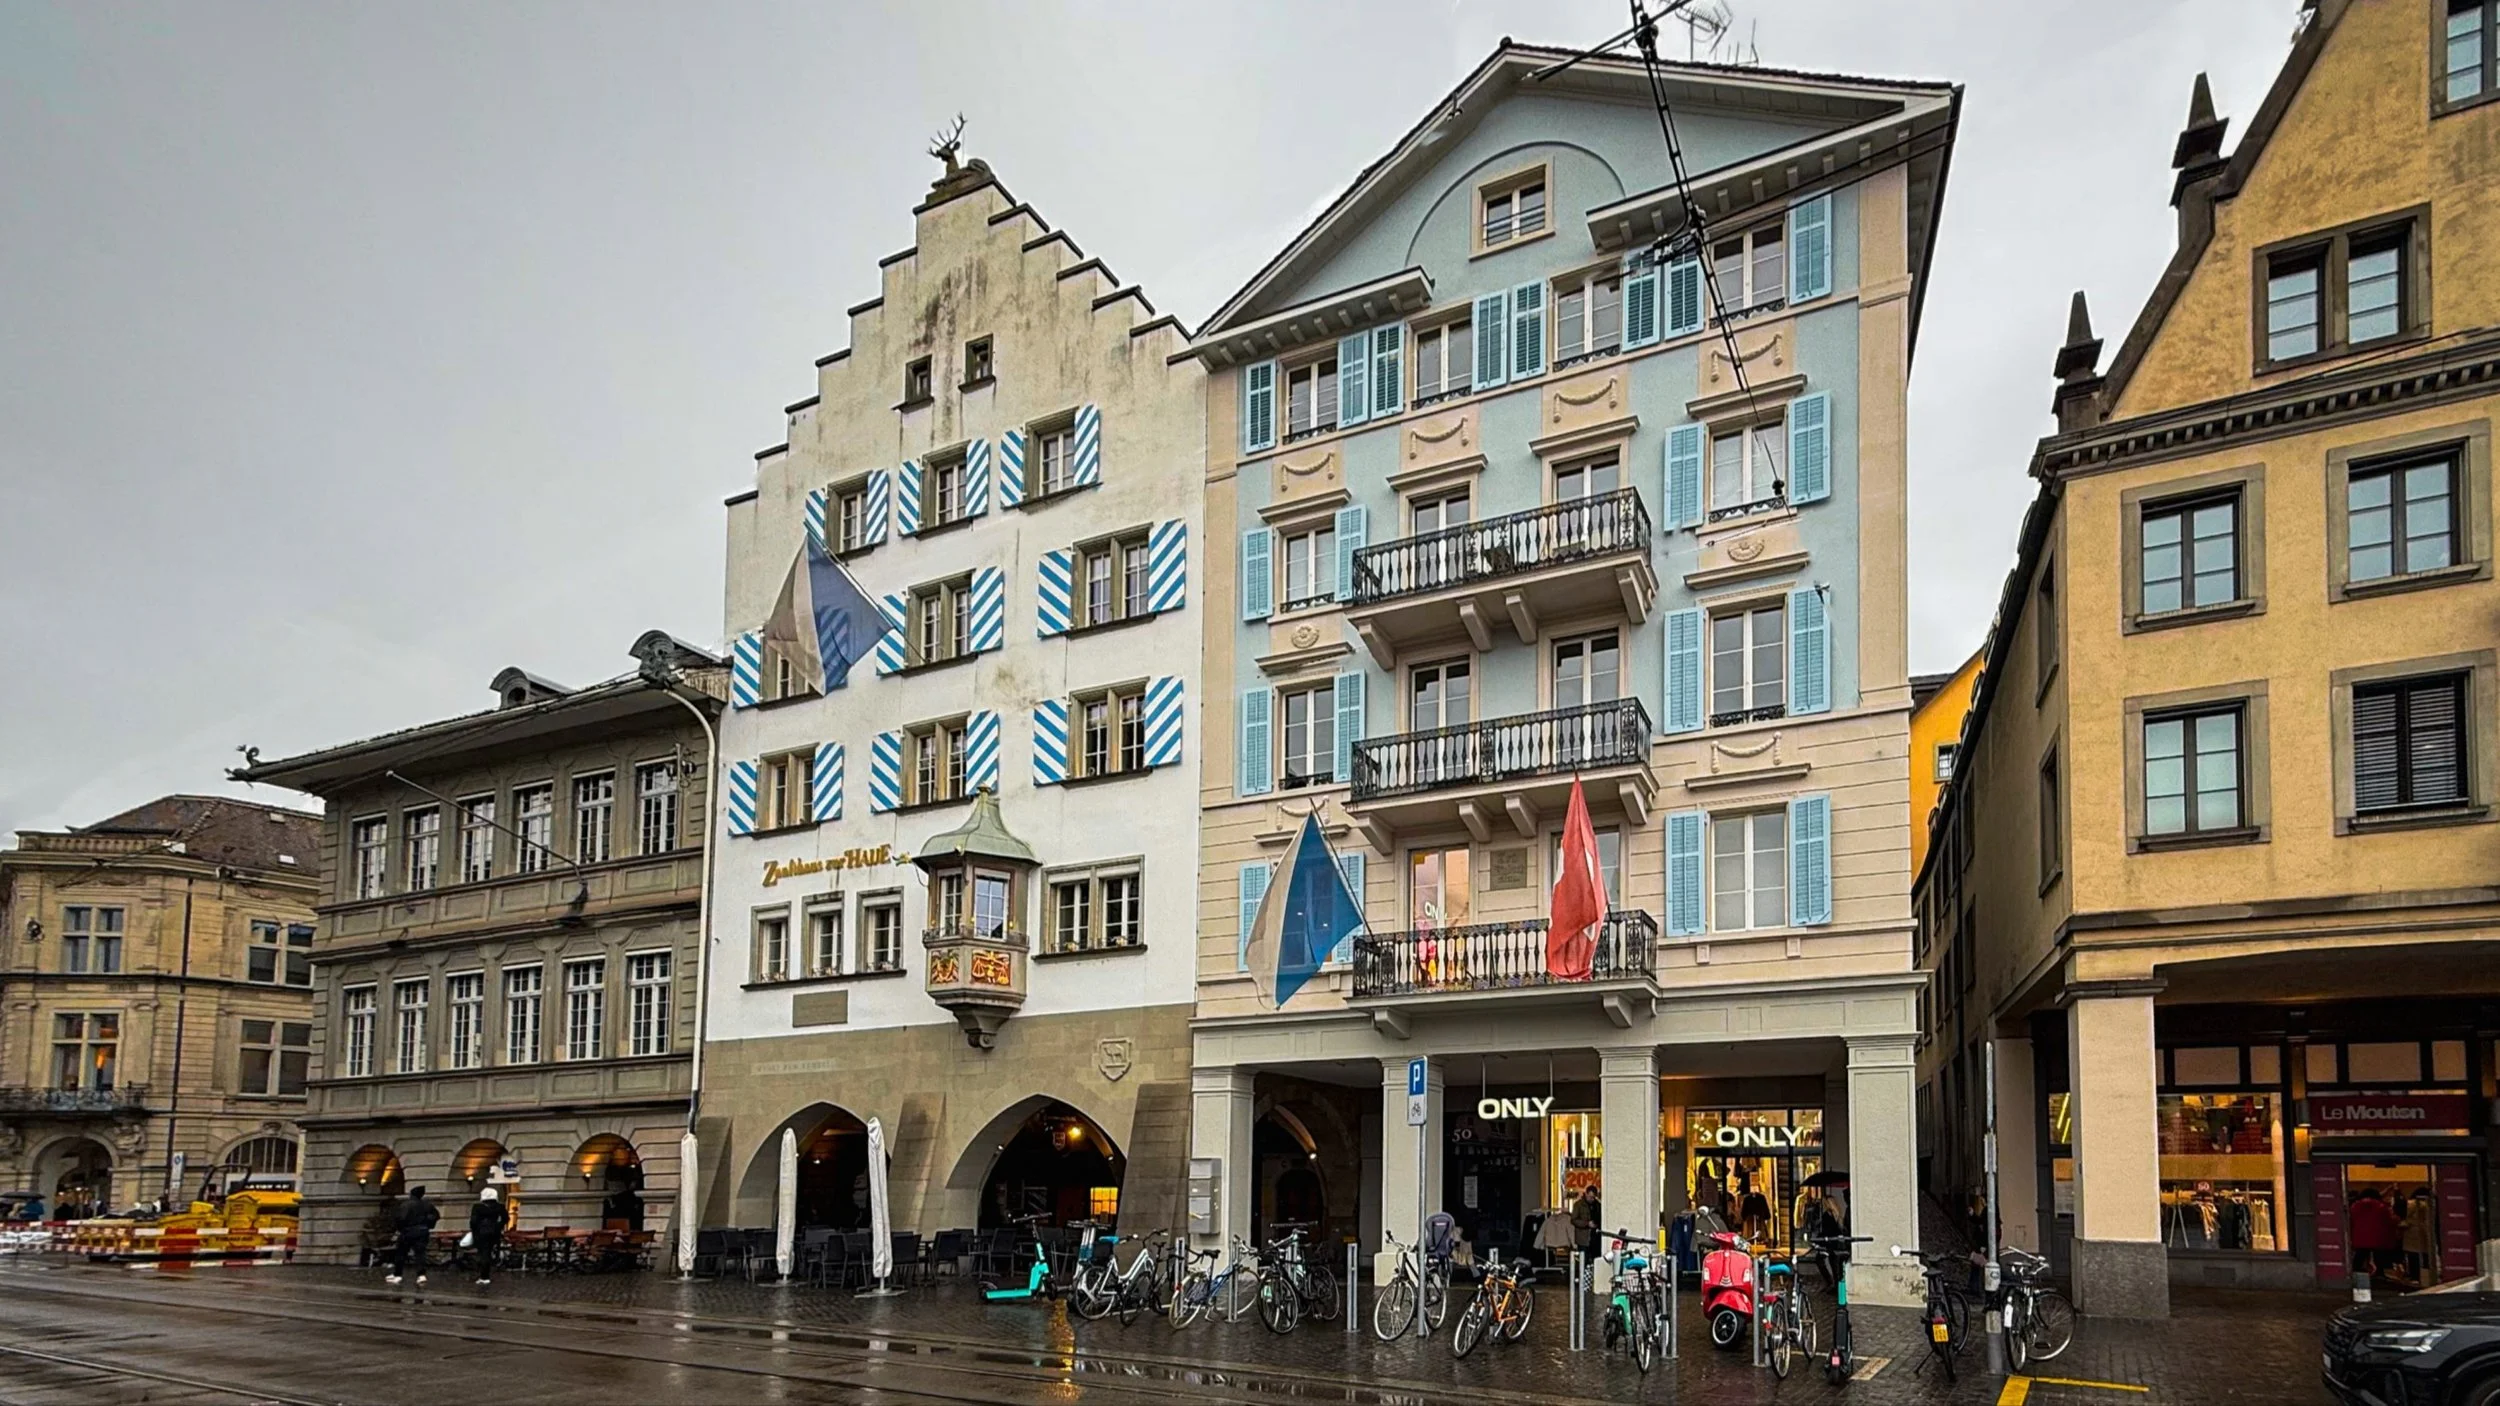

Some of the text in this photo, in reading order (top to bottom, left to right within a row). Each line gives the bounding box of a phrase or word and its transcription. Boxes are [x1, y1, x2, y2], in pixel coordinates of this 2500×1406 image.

[844, 843, 892, 869] HAUE
[1413, 1064, 1420, 1092] P
[1477, 1097, 1554, 1119] ONLY
[2321, 1105, 2426, 1120] Le Mouton
[1452, 1128, 1472, 1142] 50
[1716, 1126, 1804, 1147] ONLY
